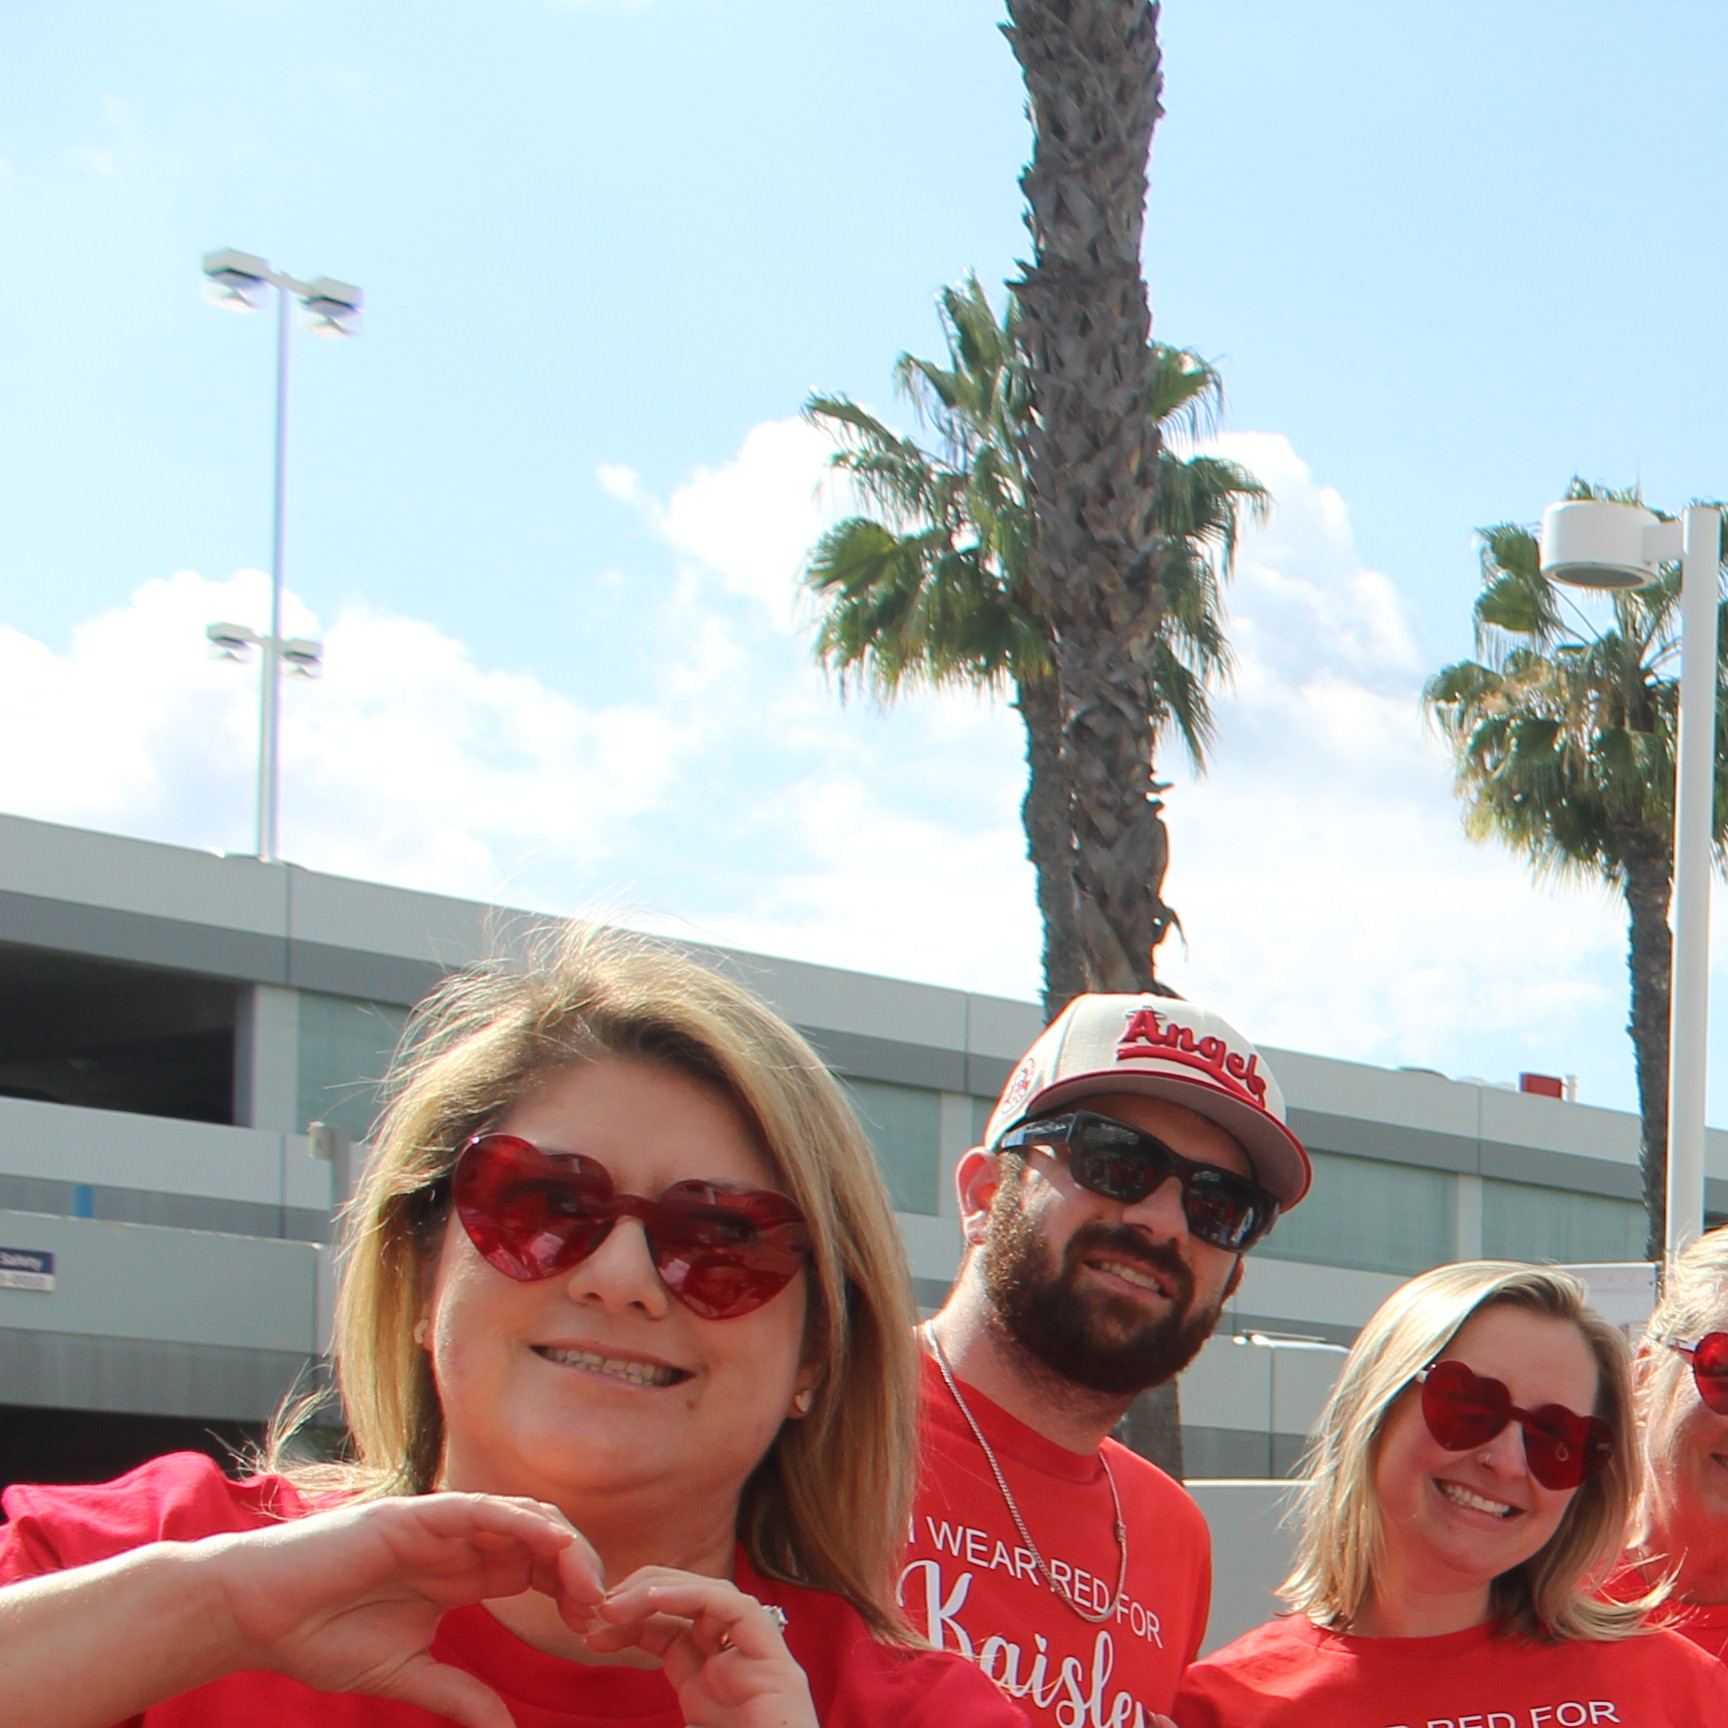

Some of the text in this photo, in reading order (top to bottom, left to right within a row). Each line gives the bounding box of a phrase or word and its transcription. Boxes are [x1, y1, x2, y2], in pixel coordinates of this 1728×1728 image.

[926, 1516, 1040, 1586] WEAR
[1050, 1557, 1110, 1614] RED
[1115, 1592, 1164, 1650] FOR
